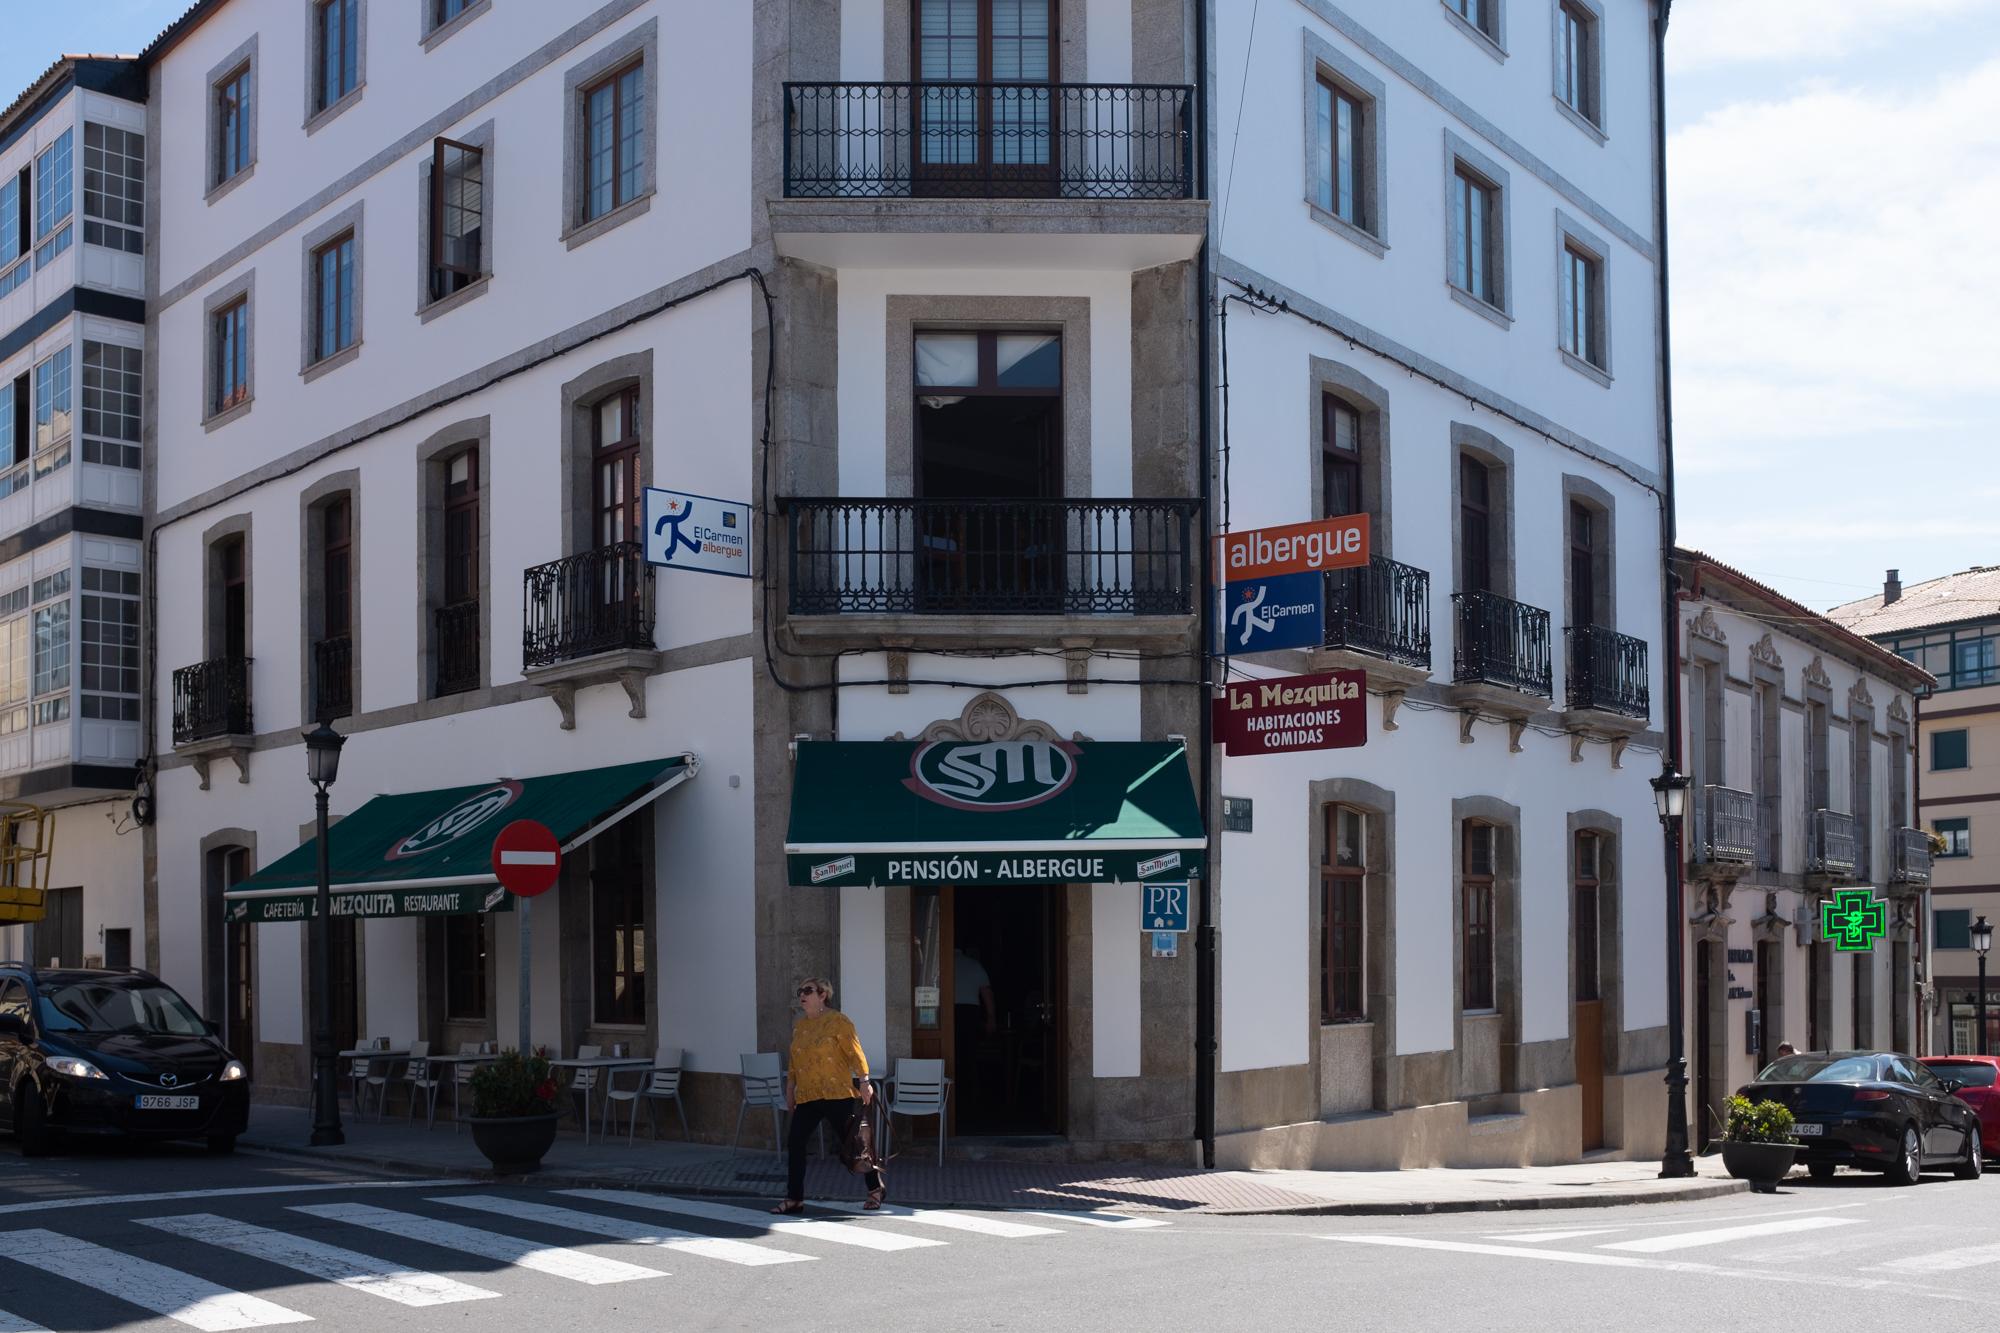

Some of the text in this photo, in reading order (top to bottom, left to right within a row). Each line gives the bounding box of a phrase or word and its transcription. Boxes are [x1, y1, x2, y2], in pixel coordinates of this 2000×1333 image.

[703, 543, 743, 558] albergue
[1231, 527, 1361, 567] albergue
[1230, 677, 1359, 710] La Mezquita
[1247, 709, 1341, 731] HABITACIONES
[1264, 728, 1324, 747] COMIDAS
[888, 855, 978, 880] PENSIÓN
[996, 858, 1104, 879] ALBERGUE
[264, 897, 304, 918] CAFETERÍA
[329, 894, 396, 916] MEZQUITA
[404, 893, 460, 912] RESTAURANTE
[1147, 887, 1183, 915] PR
[142, 1096, 196, 1108] 9766 JSP
